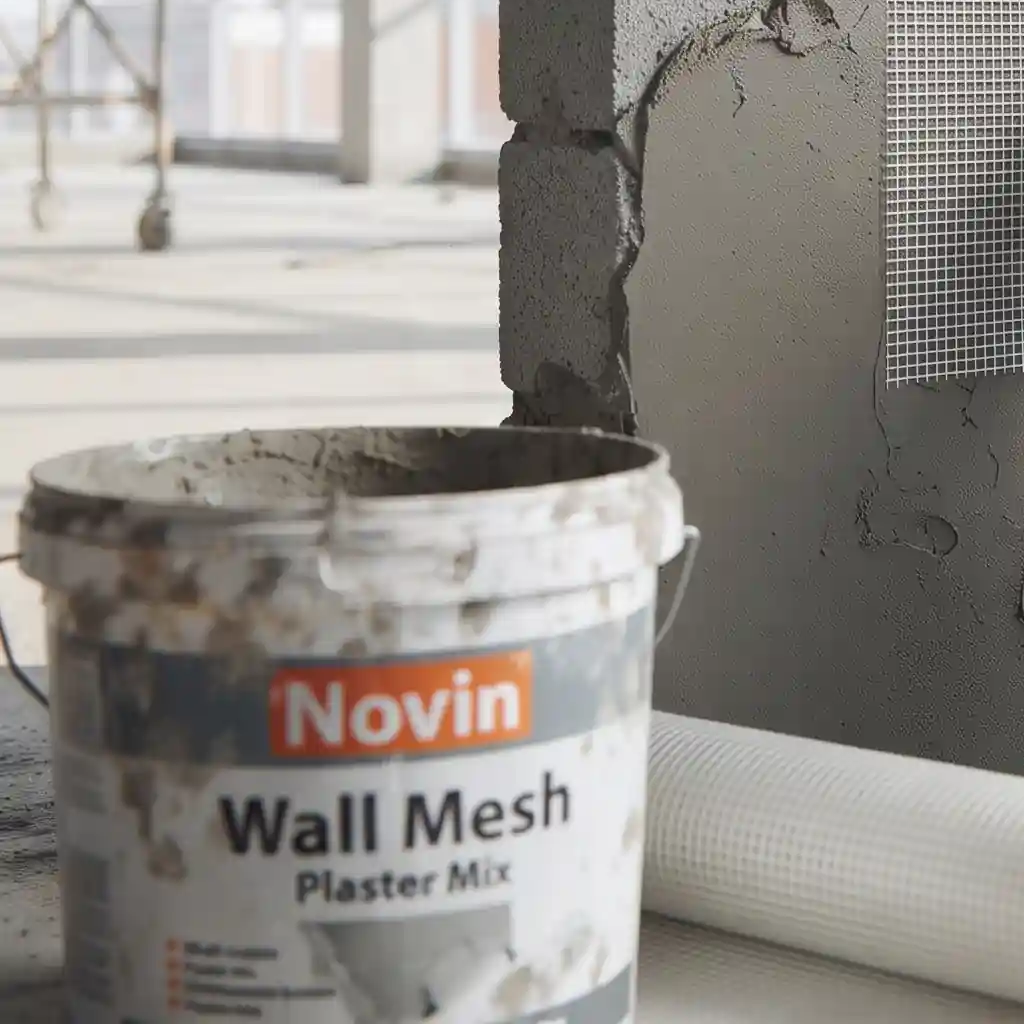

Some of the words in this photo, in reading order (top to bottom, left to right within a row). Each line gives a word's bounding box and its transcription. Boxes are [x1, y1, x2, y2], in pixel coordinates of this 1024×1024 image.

[285, 669, 520, 747] Novin
[219, 792, 377, 858] Wall
[403, 771, 571, 849] Mesh
[296, 866, 438, 905] Plaster
[447, 858, 512, 894] Mix
